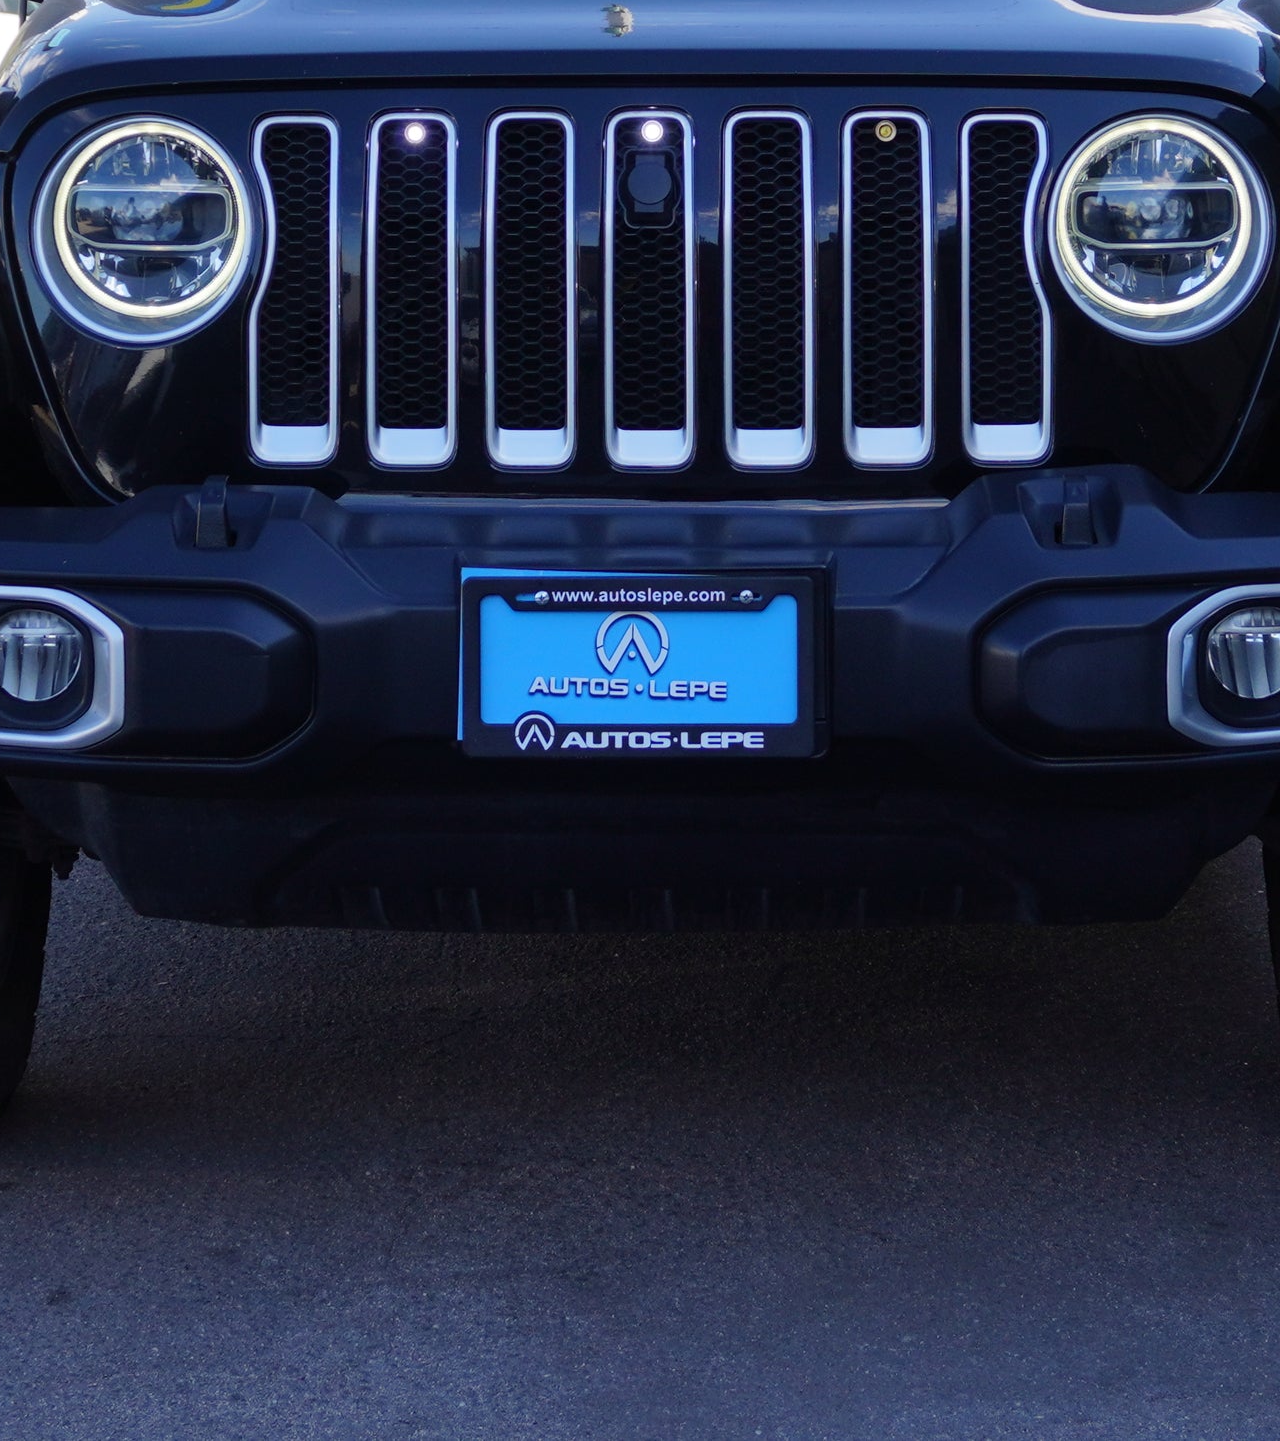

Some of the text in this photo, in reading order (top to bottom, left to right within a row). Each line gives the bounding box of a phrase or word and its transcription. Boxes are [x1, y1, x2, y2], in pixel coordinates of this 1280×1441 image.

[552, 587, 726, 605] www.autoslepe.com
[529, 676, 727, 699] AUTOS LEPE
